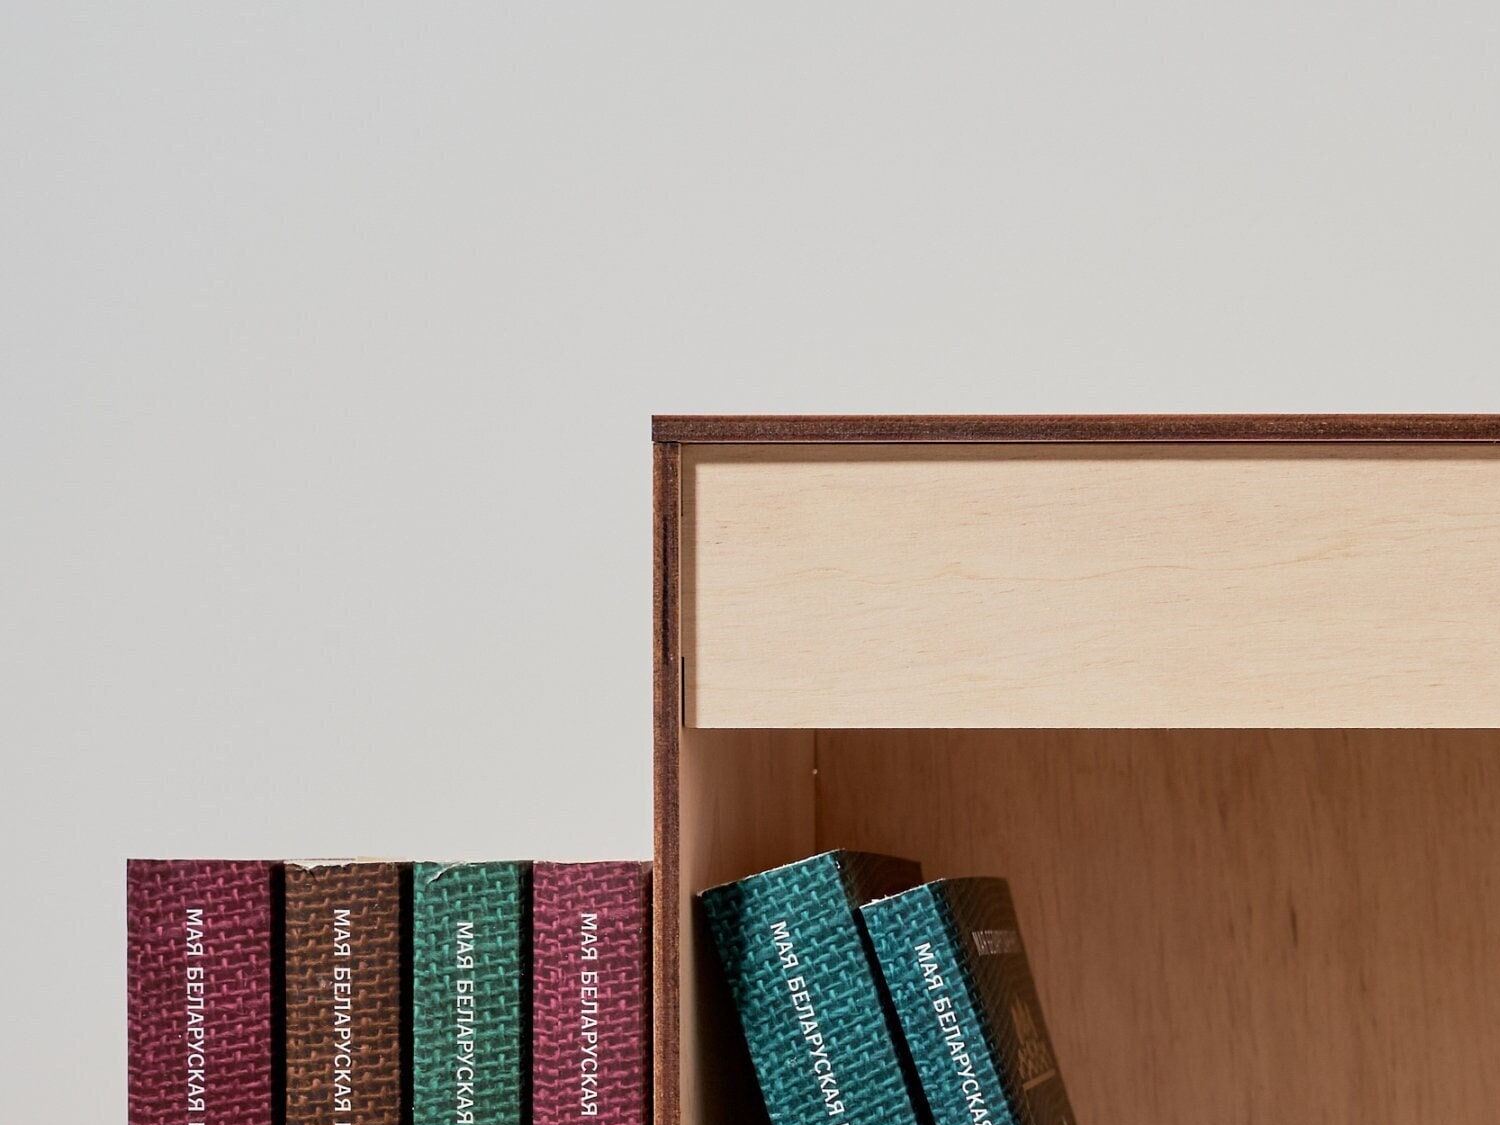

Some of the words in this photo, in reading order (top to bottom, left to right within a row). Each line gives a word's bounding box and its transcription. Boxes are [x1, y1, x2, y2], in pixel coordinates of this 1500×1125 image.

[186, 908, 206, 956] МАЯ
[333, 909, 352, 957] МАЯ
[456, 921, 474, 969] МАЯ
[580, 912, 598, 961] МАЯ
[914, 942, 944, 992] МАЯ
[186, 966, 206, 1111] БЕЛАРУСКАЯ
[333, 966, 352, 1112] БЕЛАРУСКАЯ
[456, 979, 474, 1124] БЕЛАРУСКАЯ
[580, 971, 598, 1116] БЕЛАРУСКАЯ
[770, 920, 799, 970] МАЯ
[786, 975, 845, 1116] БЕЛАРУСКАЯ
